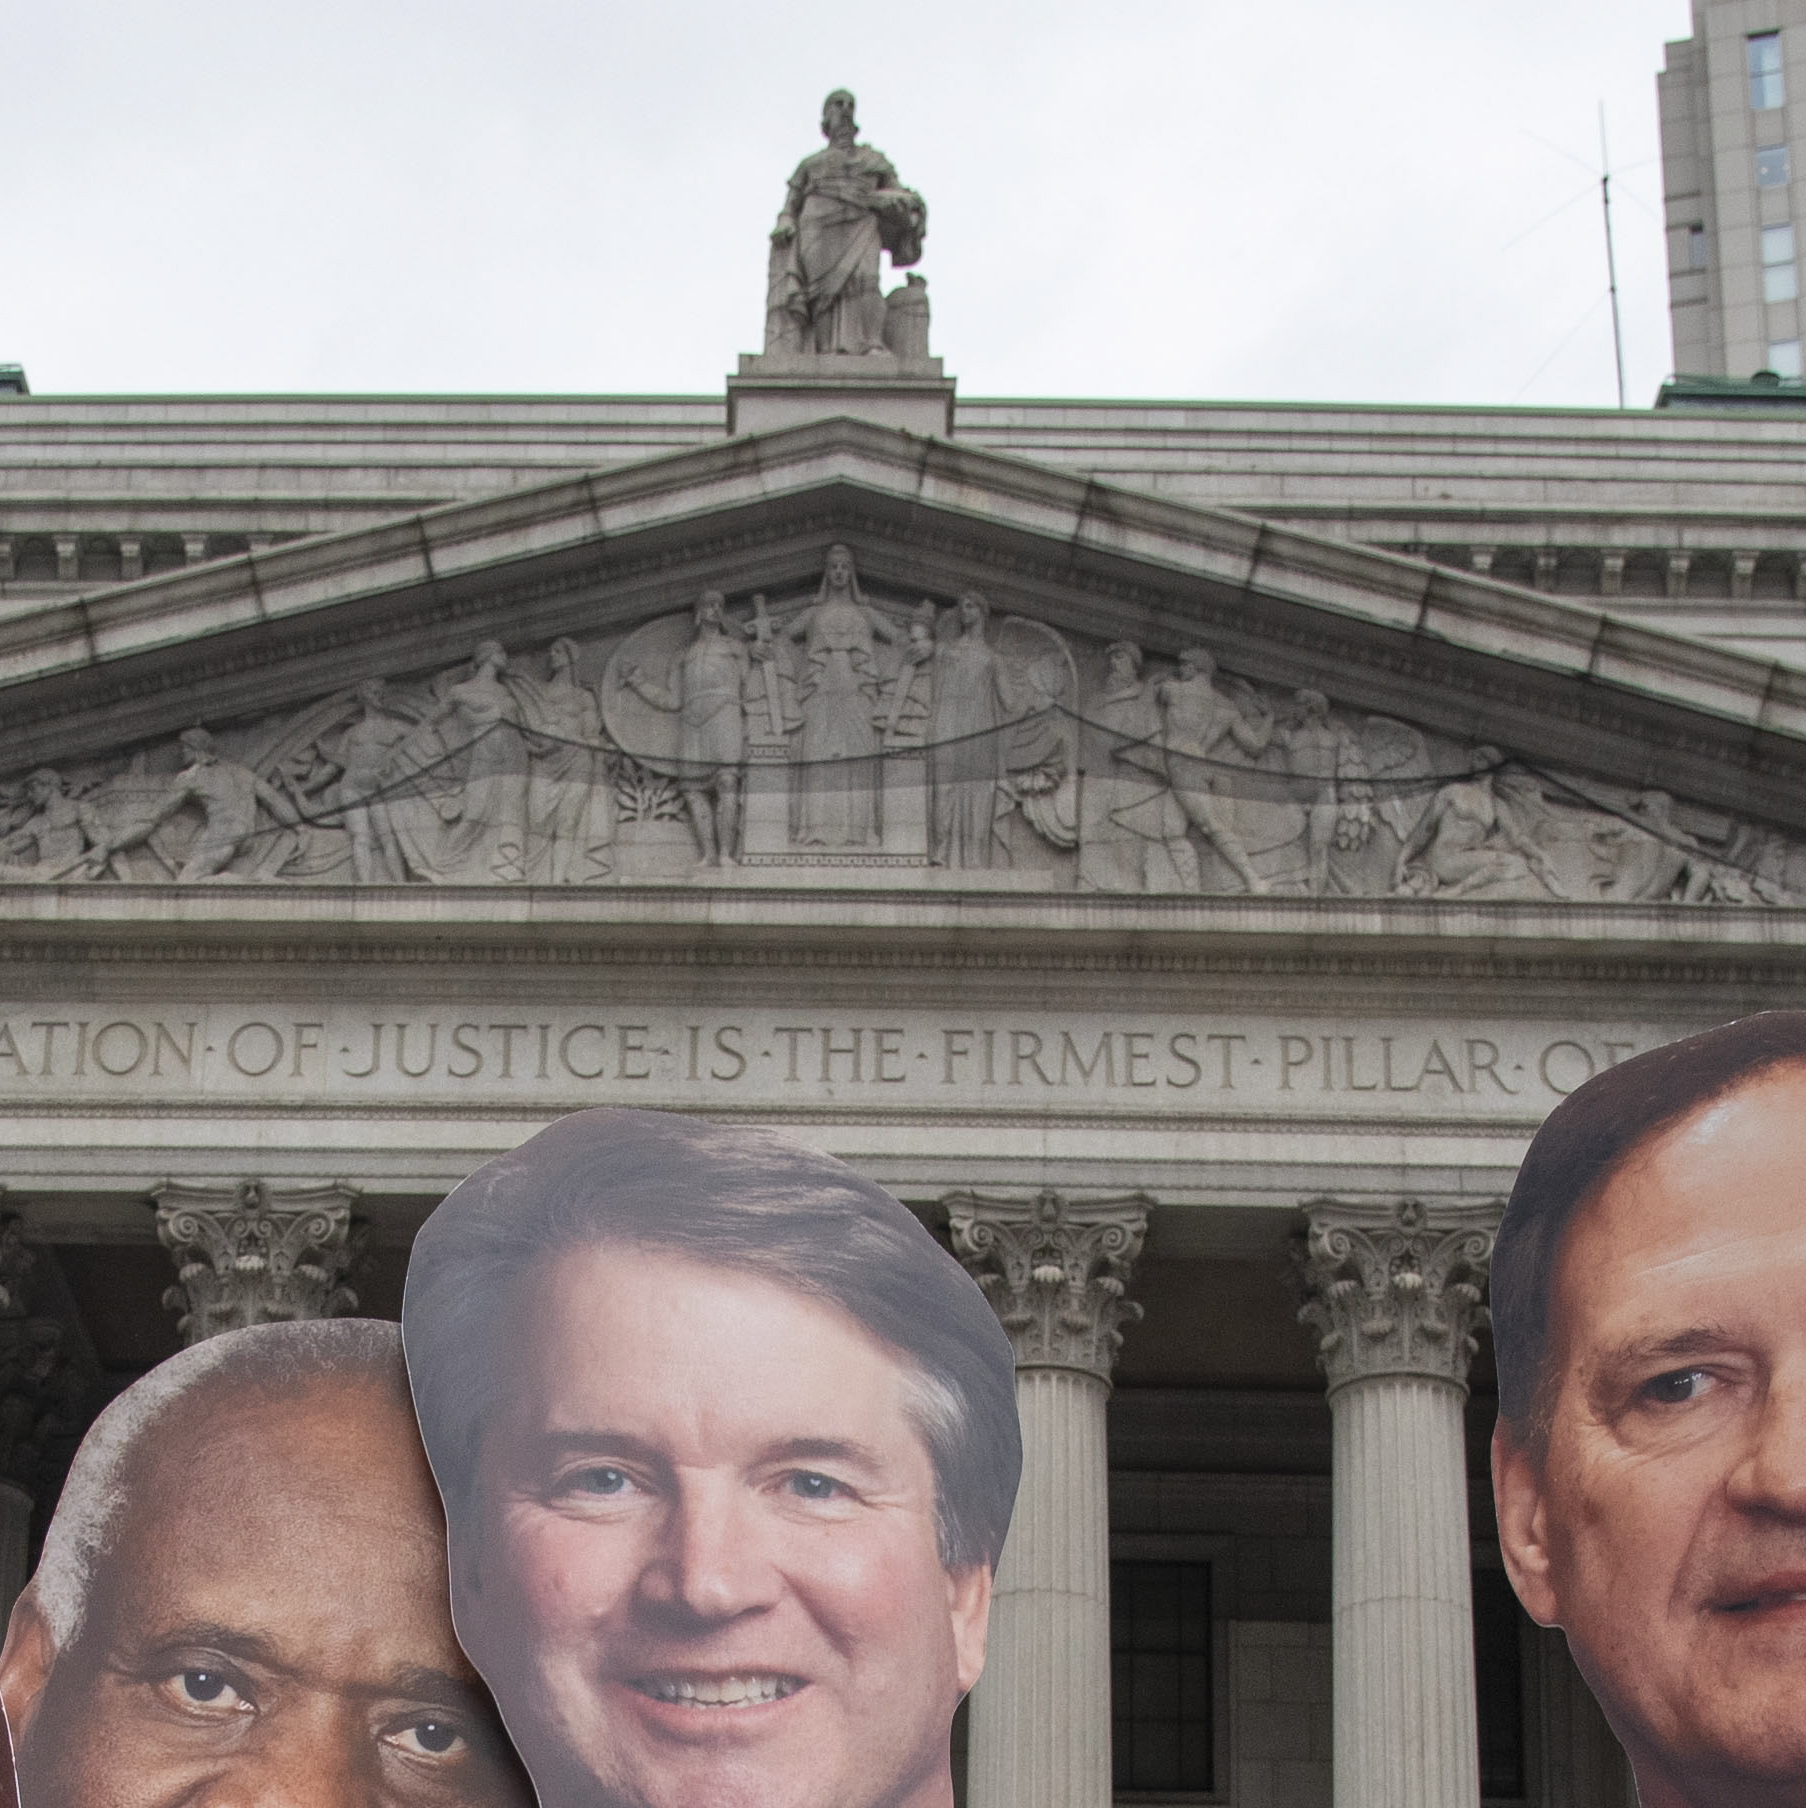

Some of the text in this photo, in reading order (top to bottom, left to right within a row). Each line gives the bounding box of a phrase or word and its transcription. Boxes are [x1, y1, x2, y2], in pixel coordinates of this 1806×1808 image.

[227, 1022, 325, 1078] OF
[341, 1022, 651, 1082] JUSTICE
[686, 1024, 748, 1082] IS
[774, 1026, 907, 1084] THE
[940, 1028, 1247, 1092] FIRMEST
[1277, 1034, 1521, 1096] PILLAR
